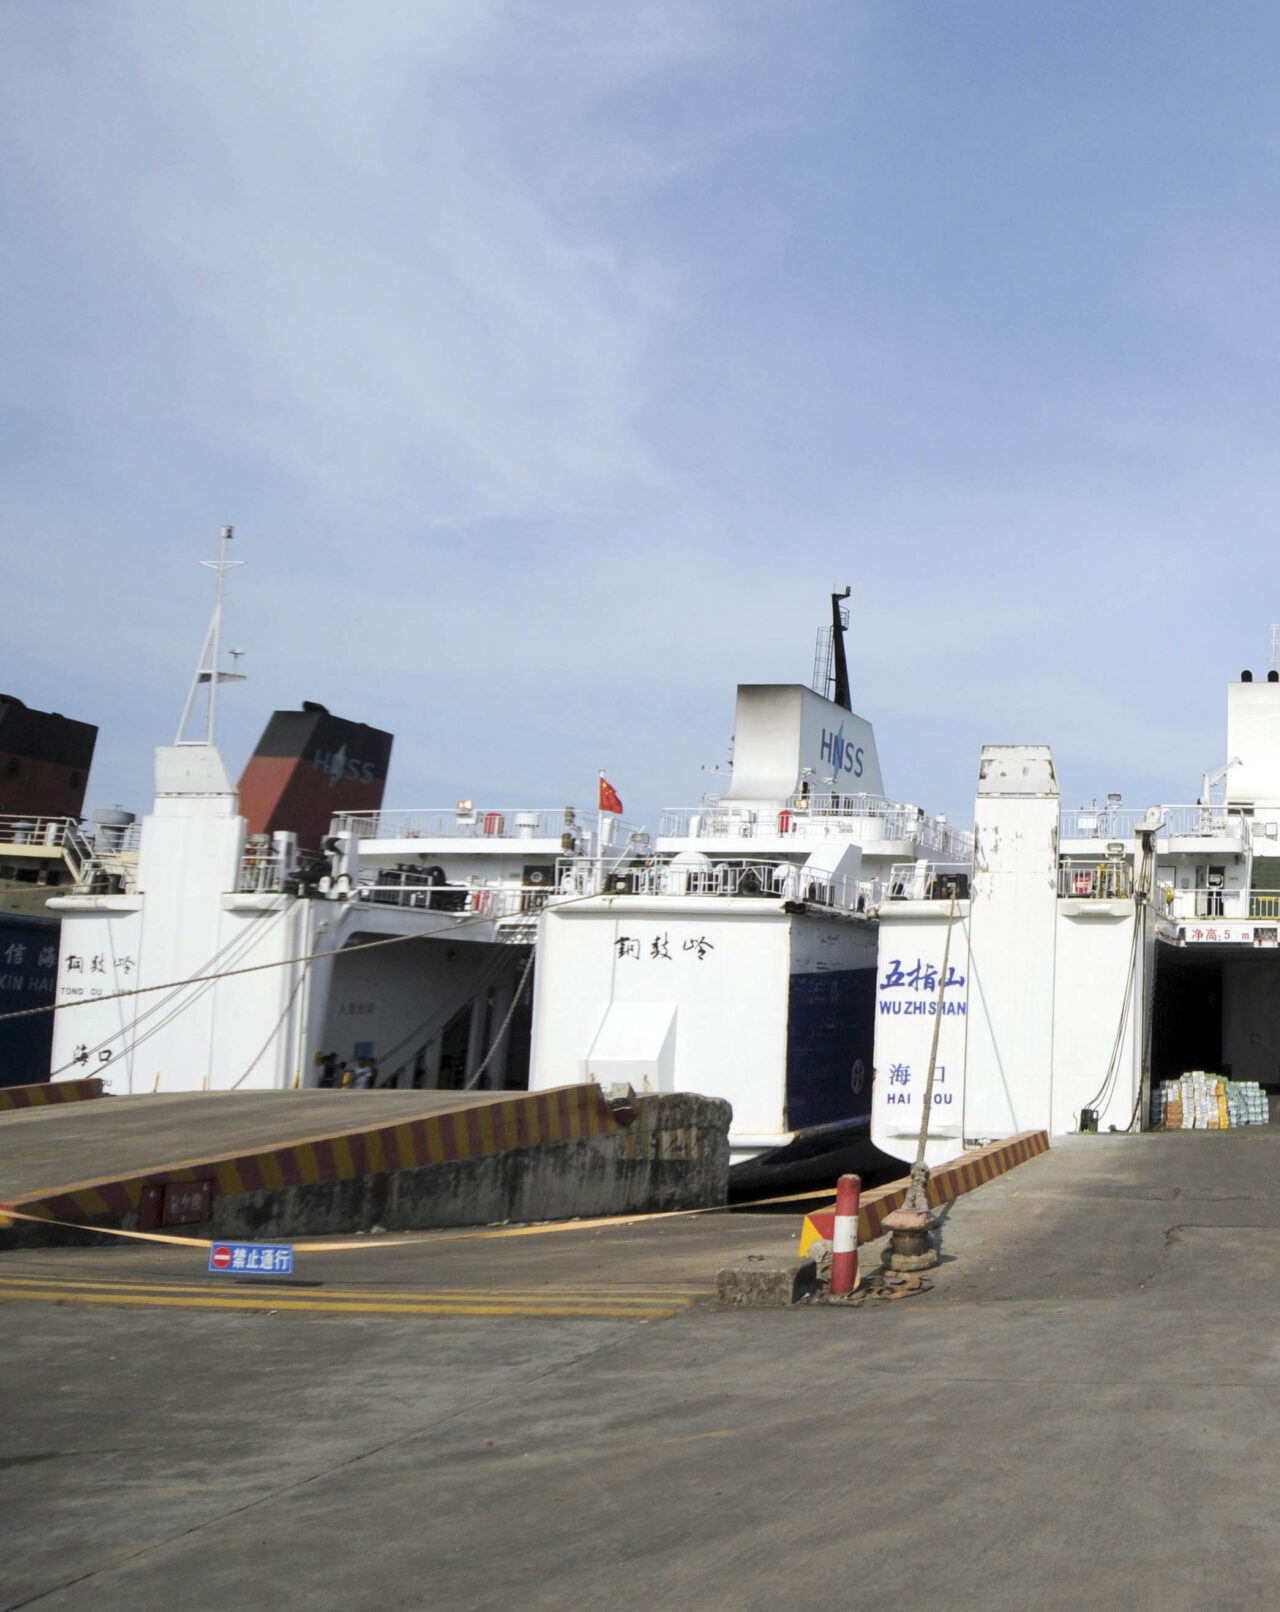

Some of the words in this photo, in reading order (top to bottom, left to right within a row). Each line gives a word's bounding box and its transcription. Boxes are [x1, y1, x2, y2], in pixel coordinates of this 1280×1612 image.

[819, 728, 864, 778] HNSS
[879, 958, 965, 993] 五指山
[887, 1093, 911, 1104] HAI
[232, 1248, 289, 1270] 禁止通行
